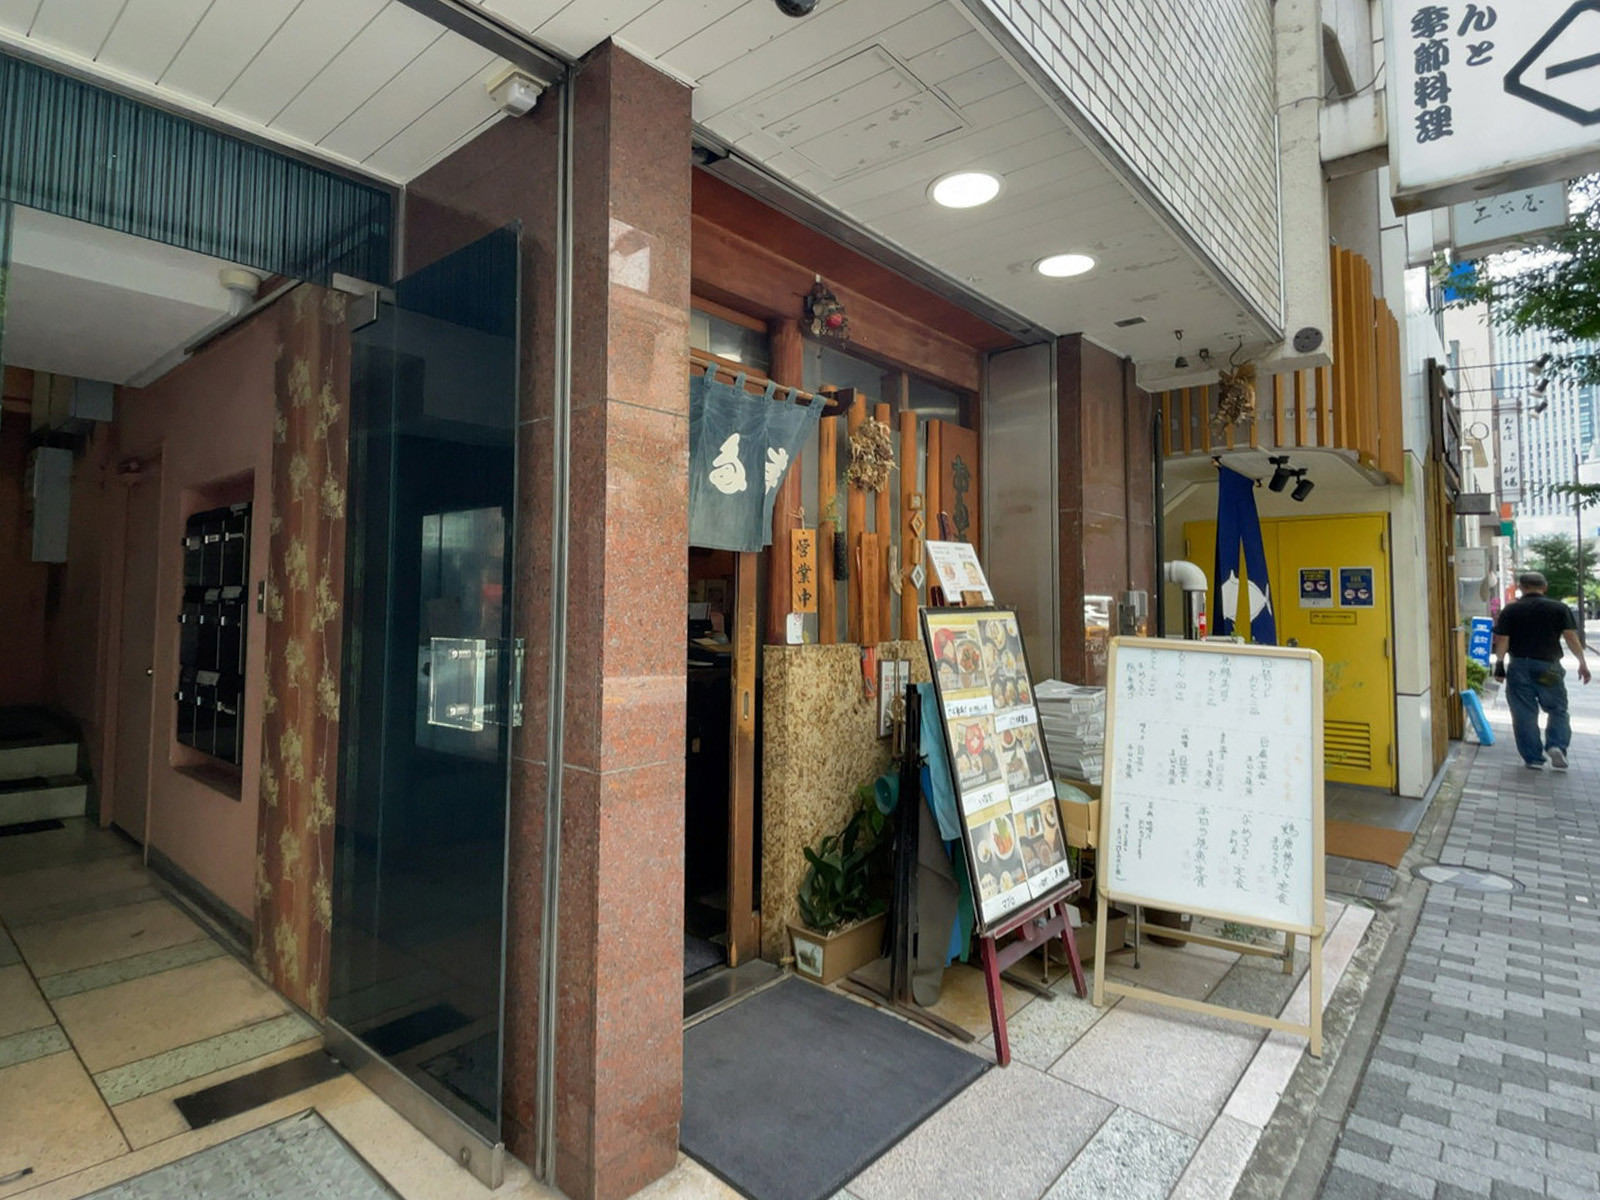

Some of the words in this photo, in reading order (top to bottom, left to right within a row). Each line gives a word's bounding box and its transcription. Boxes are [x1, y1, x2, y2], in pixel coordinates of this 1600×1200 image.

[1410, 5, 1454, 144] 季節料理
[795, 538, 812, 609] 営業中
